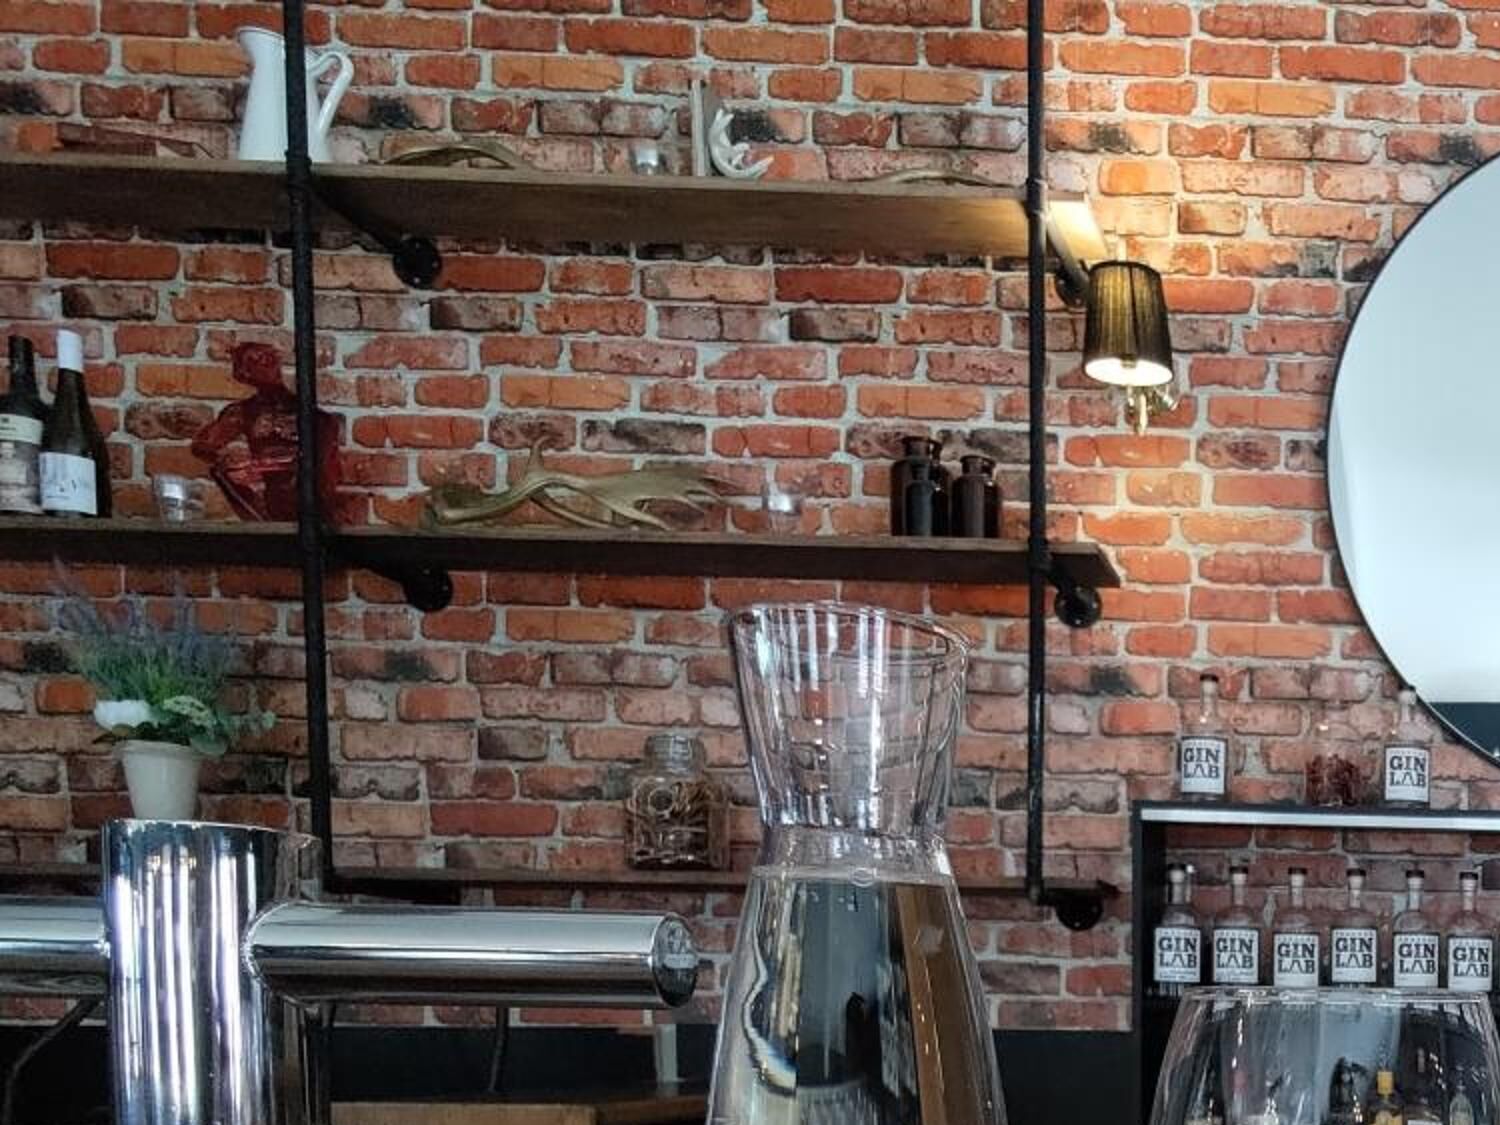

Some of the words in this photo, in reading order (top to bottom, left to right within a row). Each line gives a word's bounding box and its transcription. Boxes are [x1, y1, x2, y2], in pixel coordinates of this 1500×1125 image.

[1184, 748, 1219, 762] GIN
[1390, 755, 1426, 770] GIN
[1184, 764, 1219, 778] LAB
[1390, 771, 1426, 787] LAB
[1159, 938, 1197, 952] GIN
[1216, 938, 1253, 952] GIN
[1278, 943, 1315, 958] GIN
[1335, 938, 1373, 952] GIN
[1398, 944, 1435, 959] GIN
[1159, 954, 1197, 968] LAB
[1216, 954, 1253, 968] LAB
[1335, 954, 1373, 968] LAB
[1453, 947, 1489, 962] GIN
[1278, 959, 1315, 974] LAB
[1399, 959, 1436, 974] LAB
[1453, 962, 1489, 977] LAB
